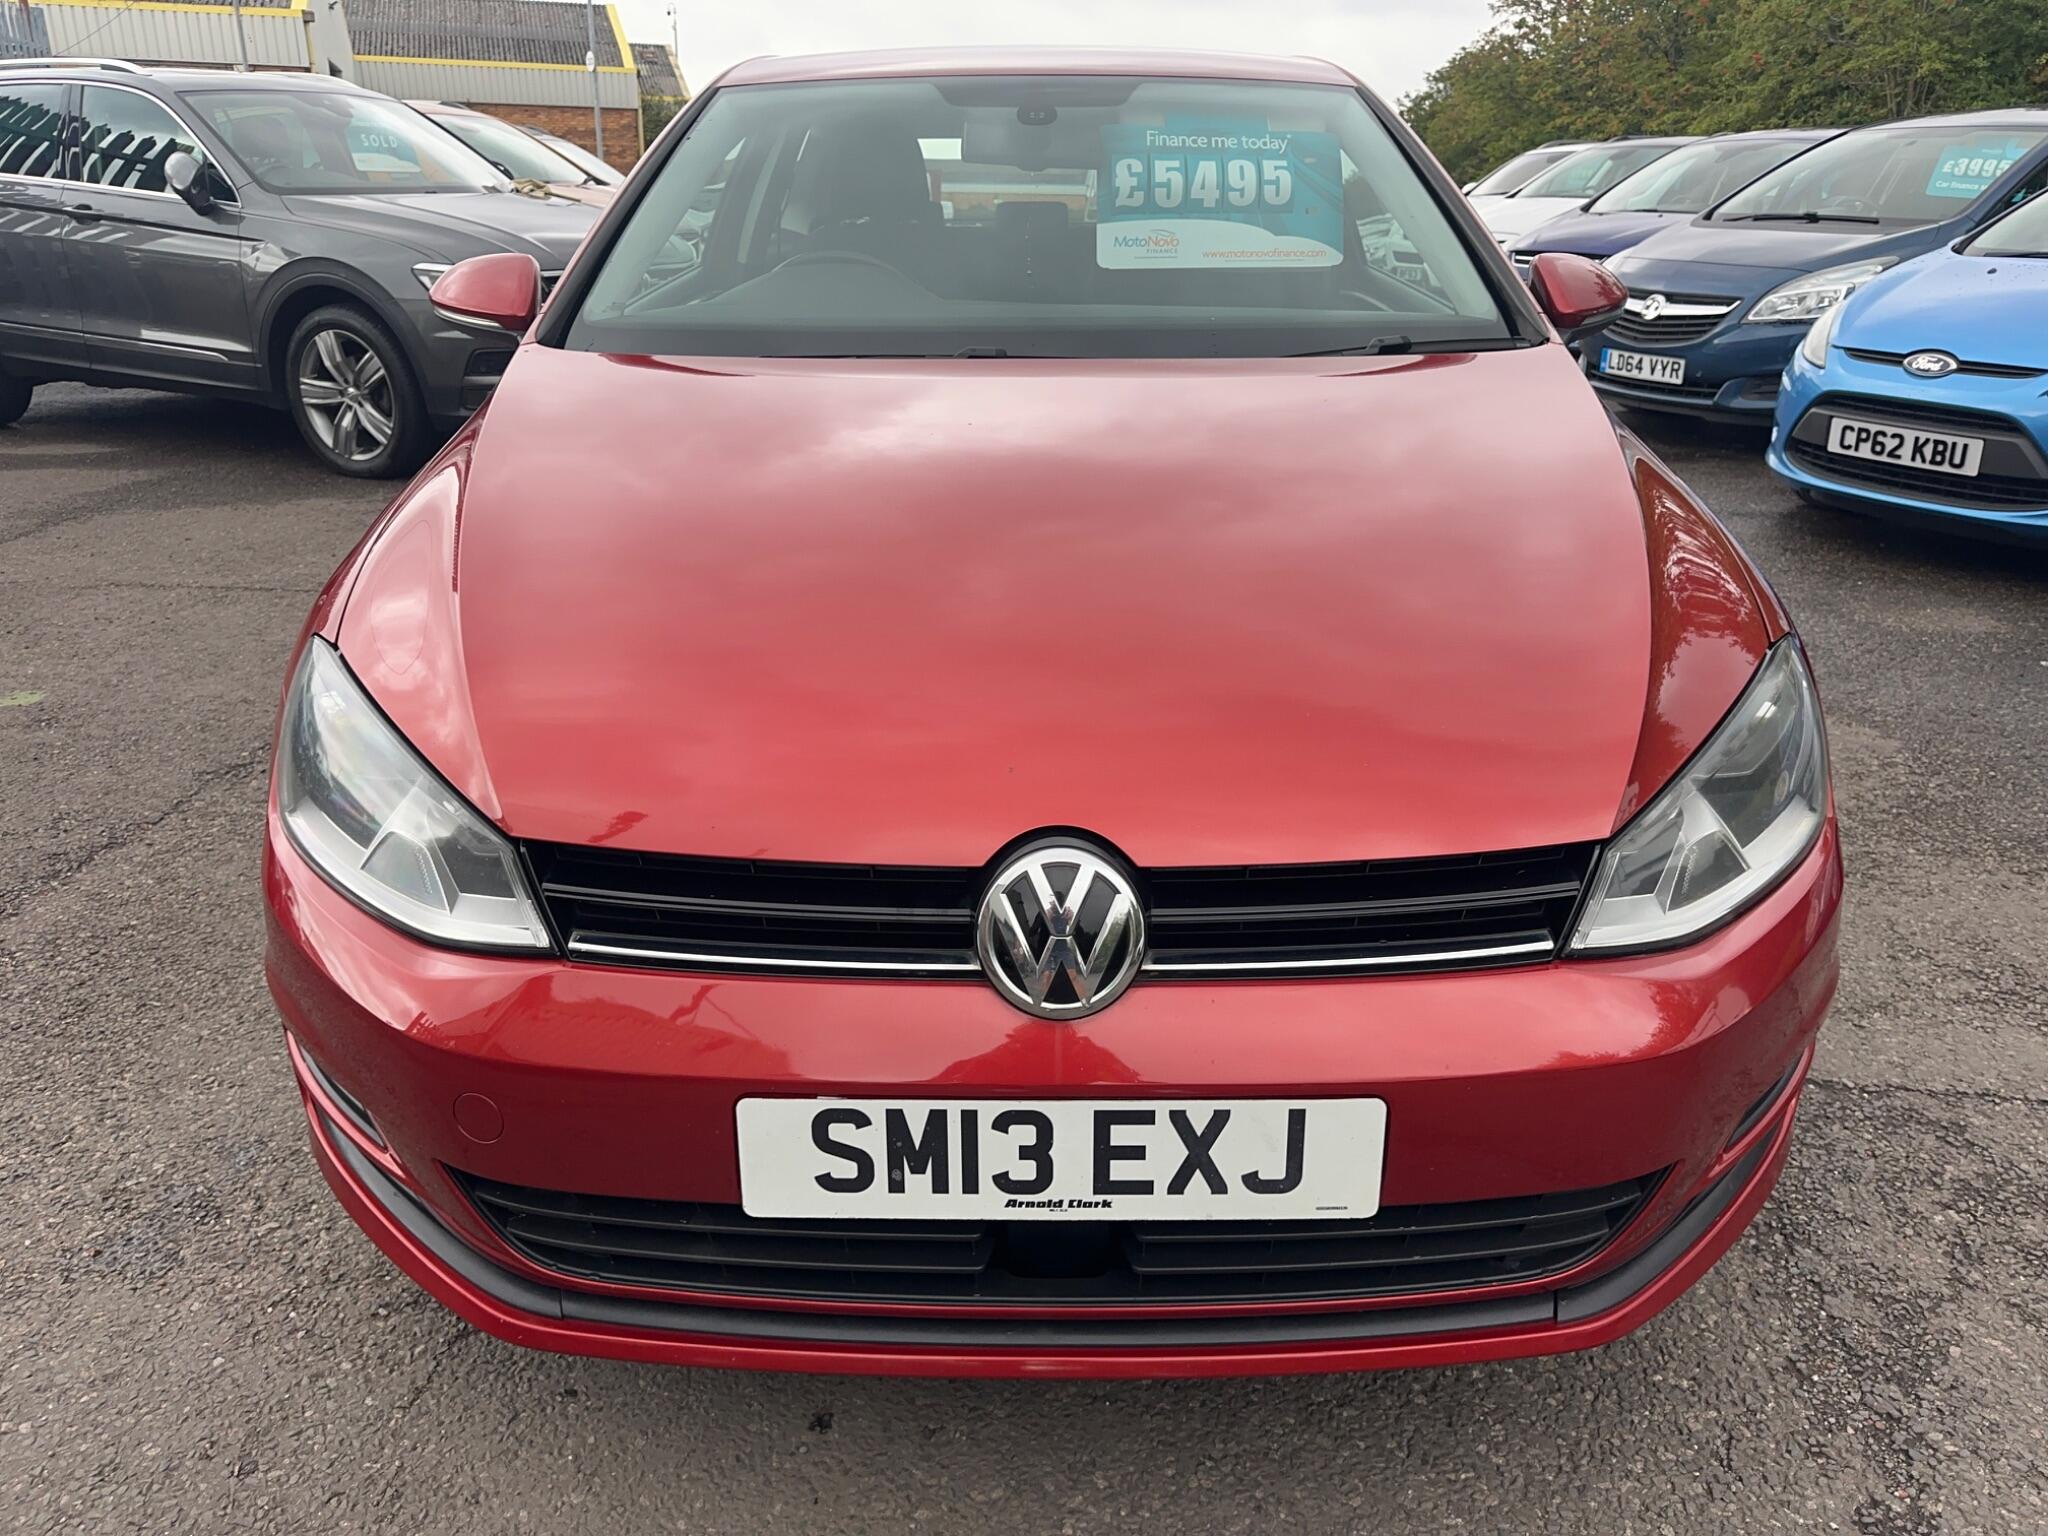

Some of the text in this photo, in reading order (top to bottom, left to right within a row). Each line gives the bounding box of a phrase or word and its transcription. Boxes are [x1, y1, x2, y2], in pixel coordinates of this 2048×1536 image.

[361, 133, 398, 148] SOLD
[1146, 130, 1208, 148] Finance
[1211, 135, 1238, 148] me
[1114, 158, 1292, 209] £5495
[1608, 351, 1681, 380] LD64 VYR
[1911, 355, 1944, 372] Ford
[1839, 425, 1969, 469] CP62 KBU
[811, 1107, 1308, 1196] SM13 EXJ
[1004, 1199, 1113, 1209] Arnold Clark
